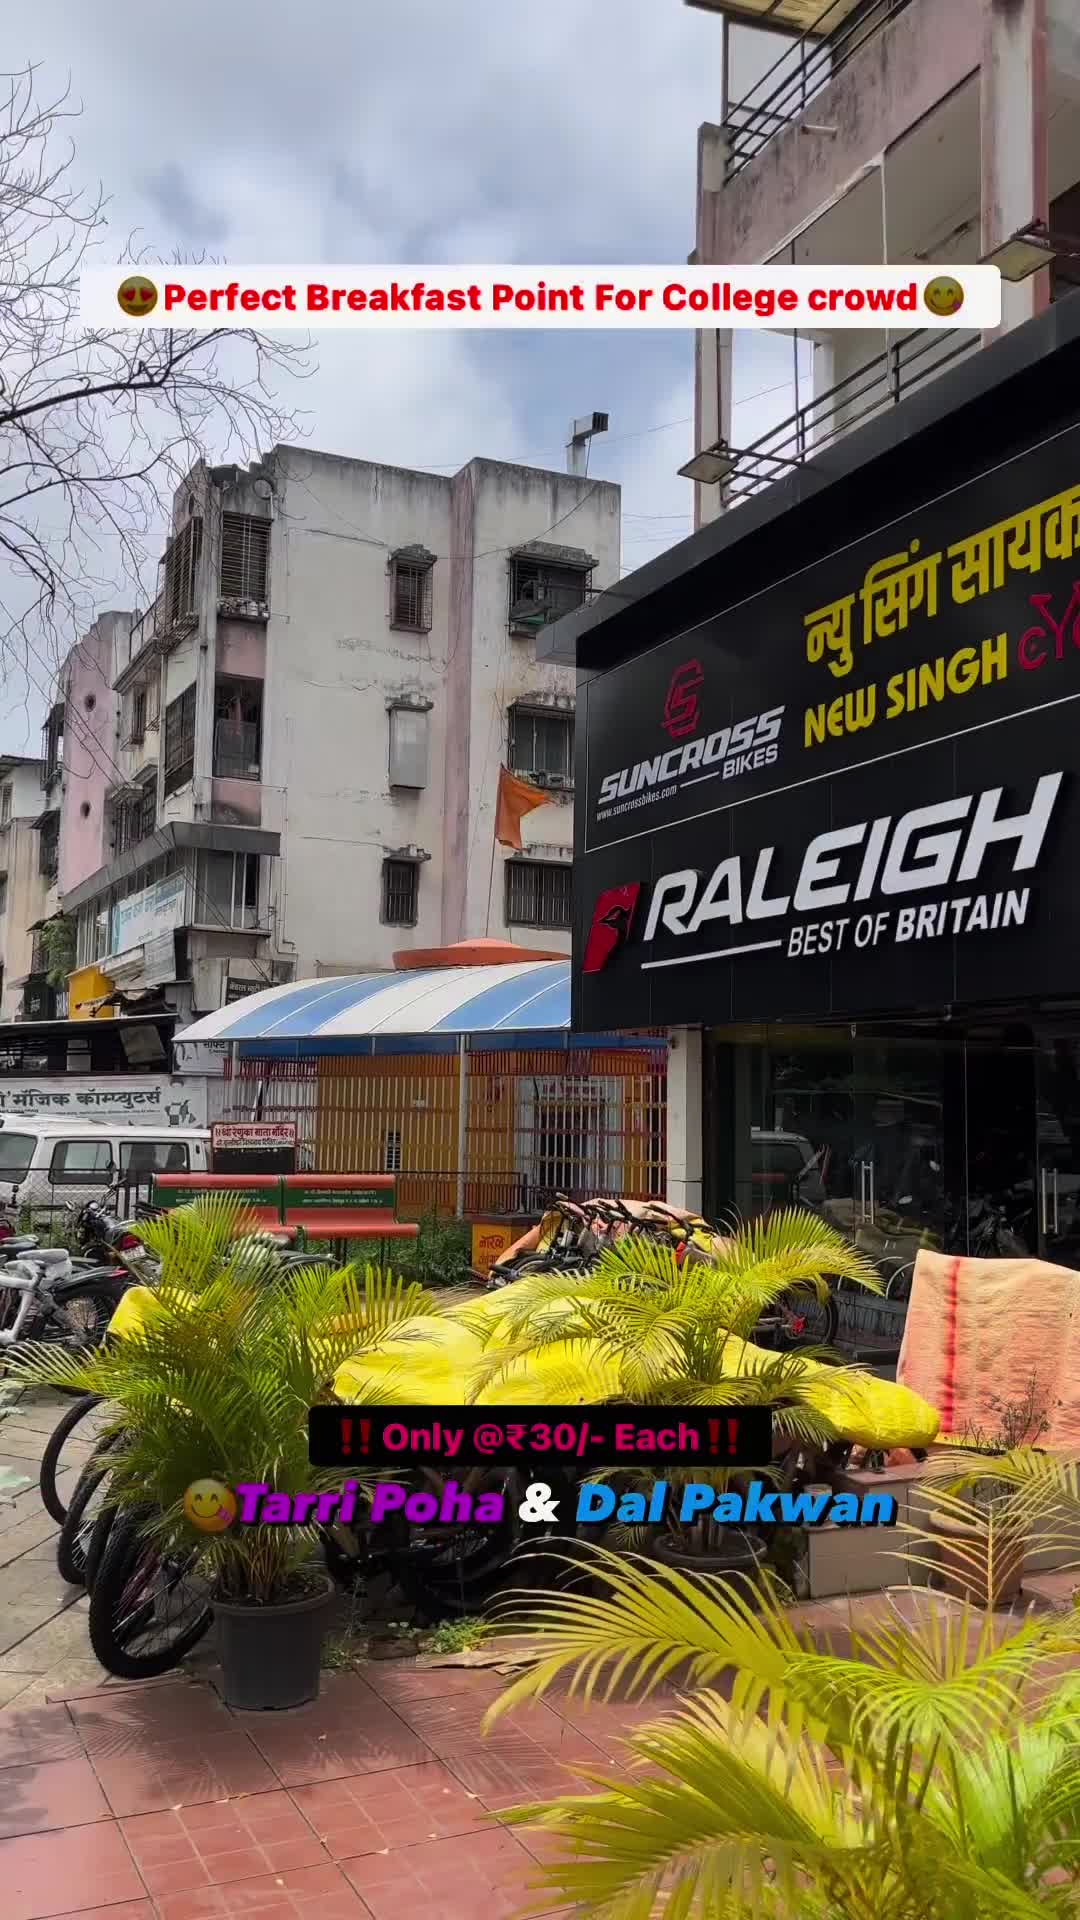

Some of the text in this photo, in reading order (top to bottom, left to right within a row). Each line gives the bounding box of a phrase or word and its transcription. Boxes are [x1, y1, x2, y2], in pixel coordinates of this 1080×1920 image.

[859, 538, 943, 645] सिंग
[804, 683, 876, 748] NEW
[886, 632, 1007, 719] SINGH
[596, 784, 677, 821] www.suncrossbikes.com
[598, 705, 785, 805] SUNCROSS
[722, 743, 778, 780] BIKES
[642, 771, 1064, 941] RALEIGH
[787, 888, 1030, 957] BEST OF BRITAIN
